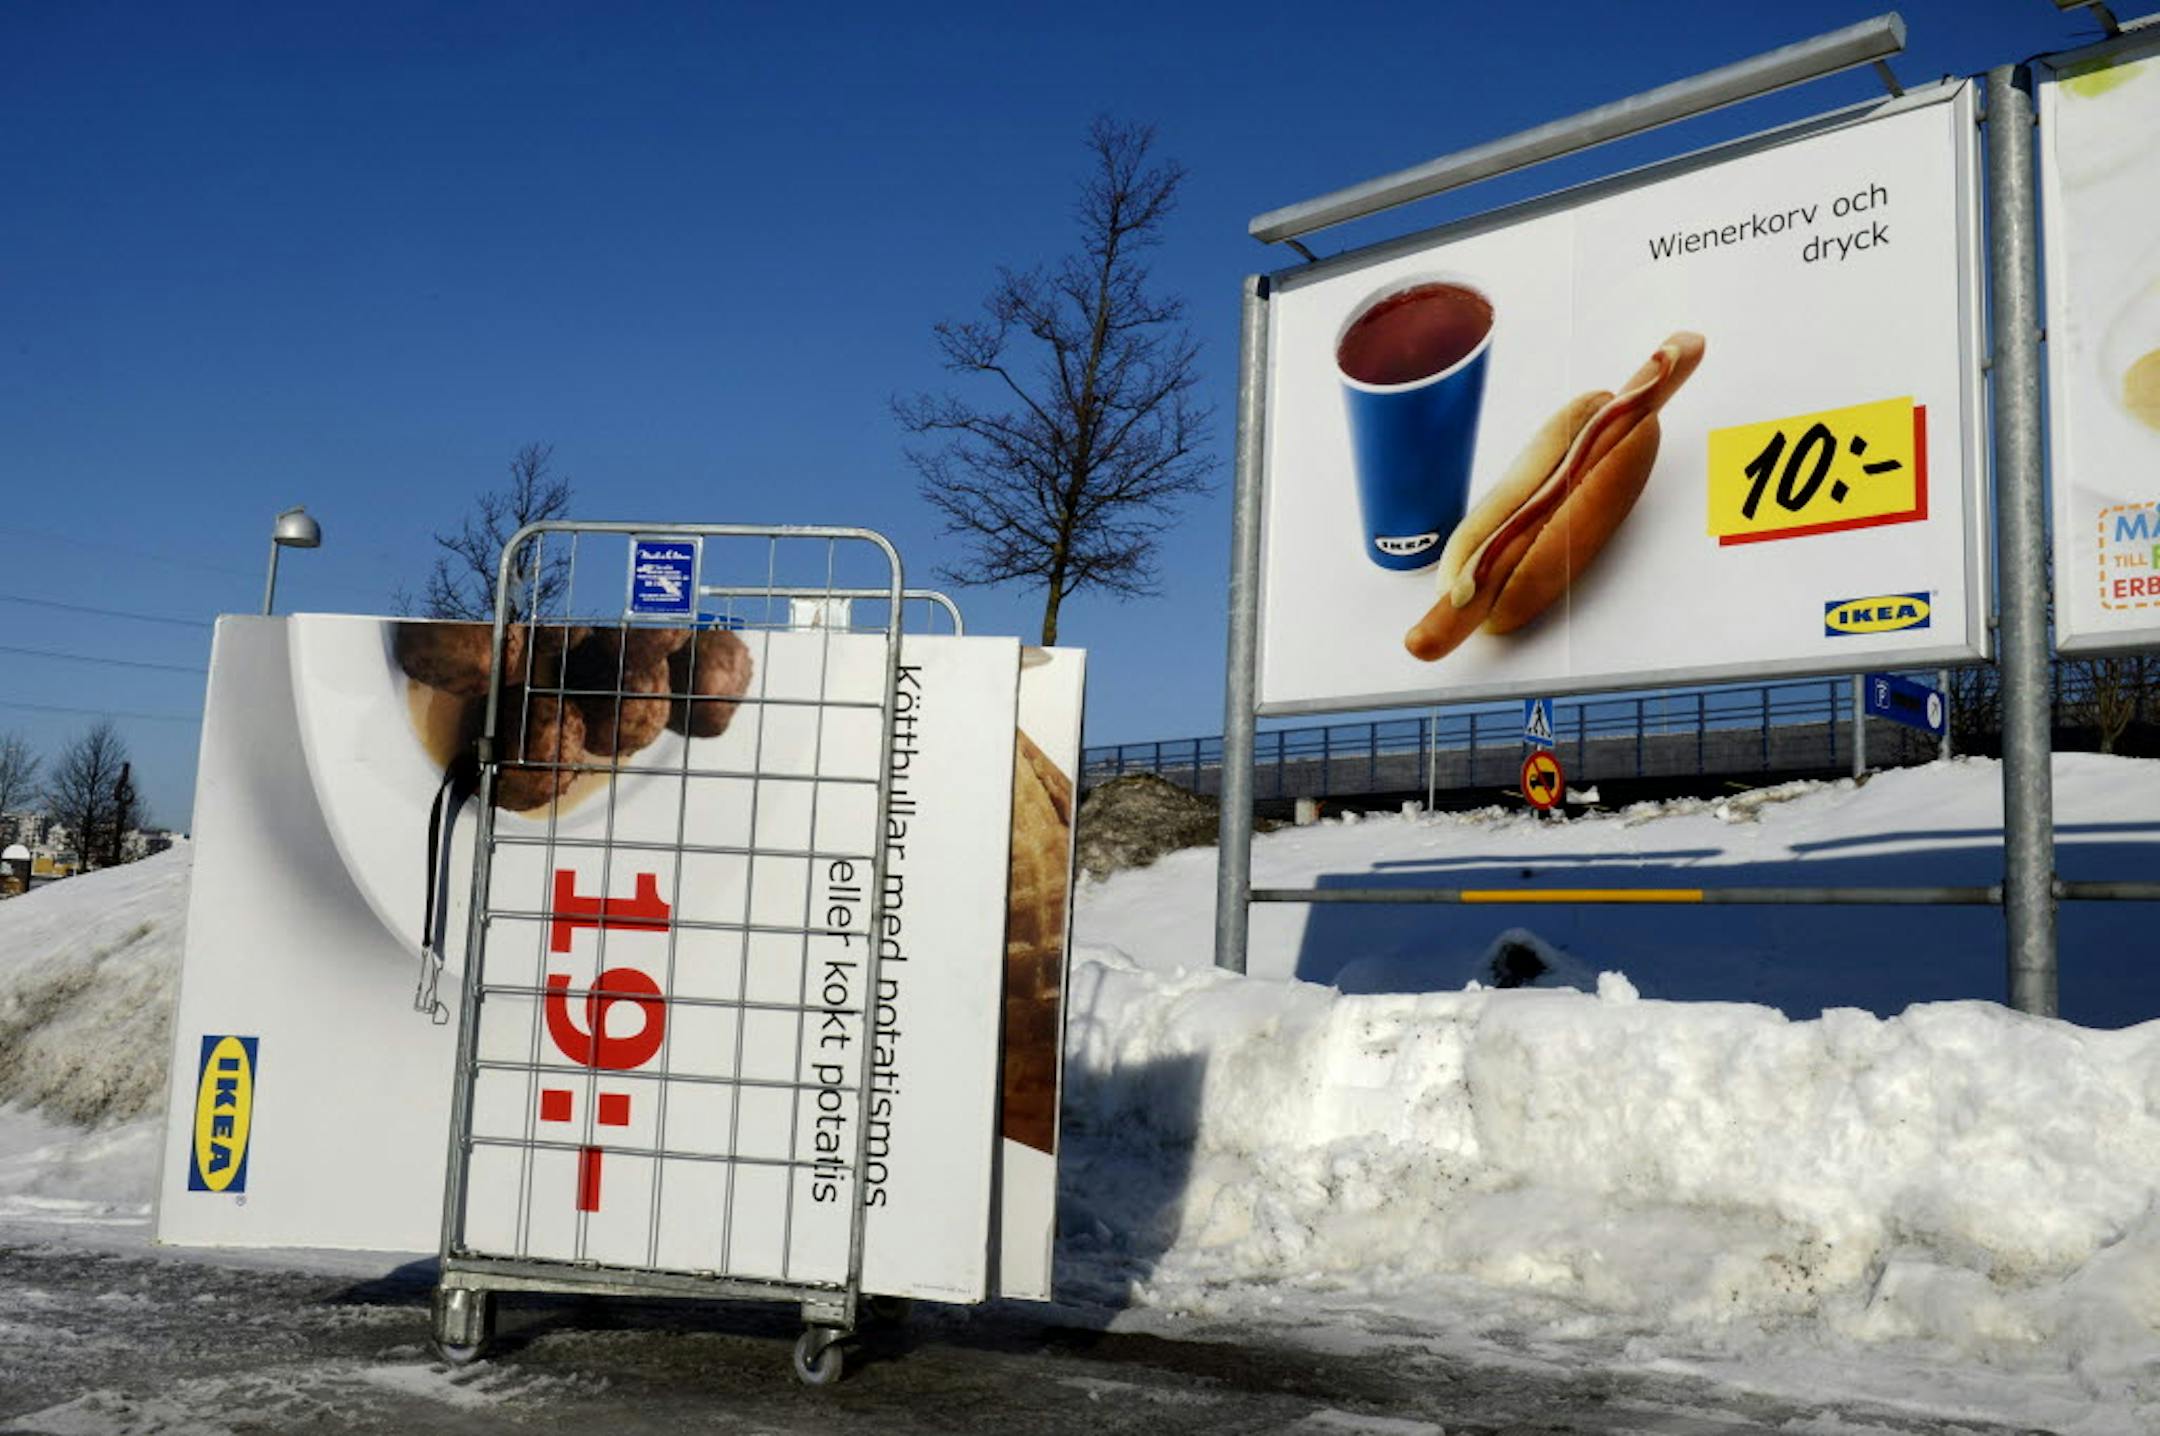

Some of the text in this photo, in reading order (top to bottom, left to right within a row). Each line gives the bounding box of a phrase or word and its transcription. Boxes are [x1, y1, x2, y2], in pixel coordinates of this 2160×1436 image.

[1649, 183, 1888, 260] Wienerkorv och
[1802, 221, 1890, 262] dryck
[1740, 421, 1904, 521] 10:-
[1382, 537, 1431, 550] IKEA
[2113, 552, 2148, 568] TILL
[1838, 603, 1918, 625] IKEA
[863, 665, 923, 1208] Köttbullar med potatismos
[540, 868, 672, 1213] 19:-
[811, 859, 862, 1203] eller kokt potatis
[207, 1057, 241, 1175] IKEA
